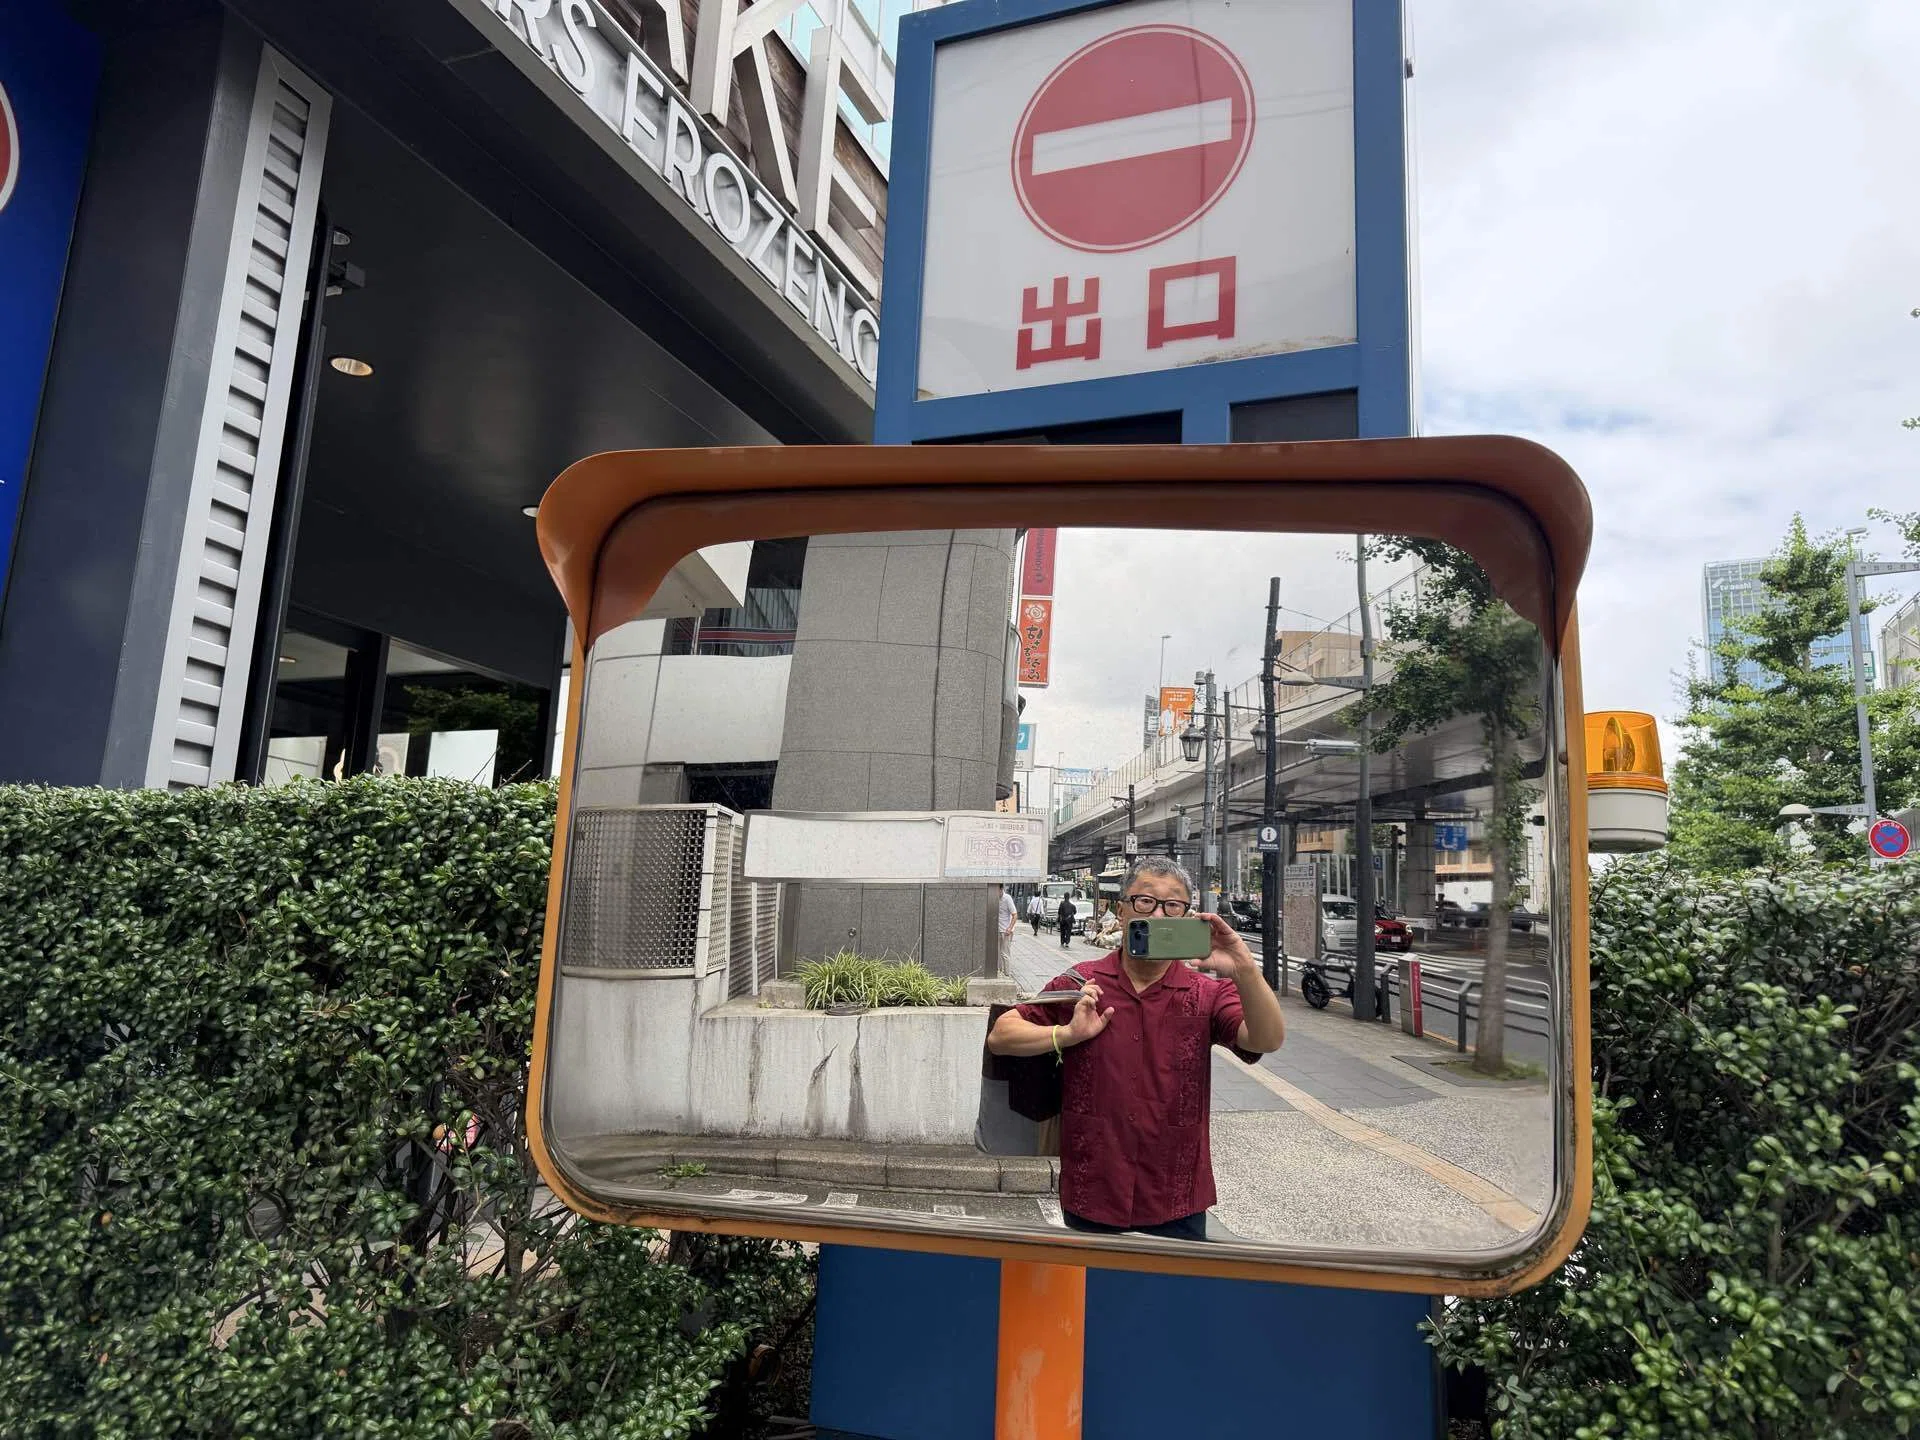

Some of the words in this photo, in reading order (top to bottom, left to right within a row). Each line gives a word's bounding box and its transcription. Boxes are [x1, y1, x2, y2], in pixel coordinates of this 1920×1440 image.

[621, 52, 846, 353] FROZEN
[643, 0, 889, 303] KE
[1016, 256, 1237, 370] 出口
